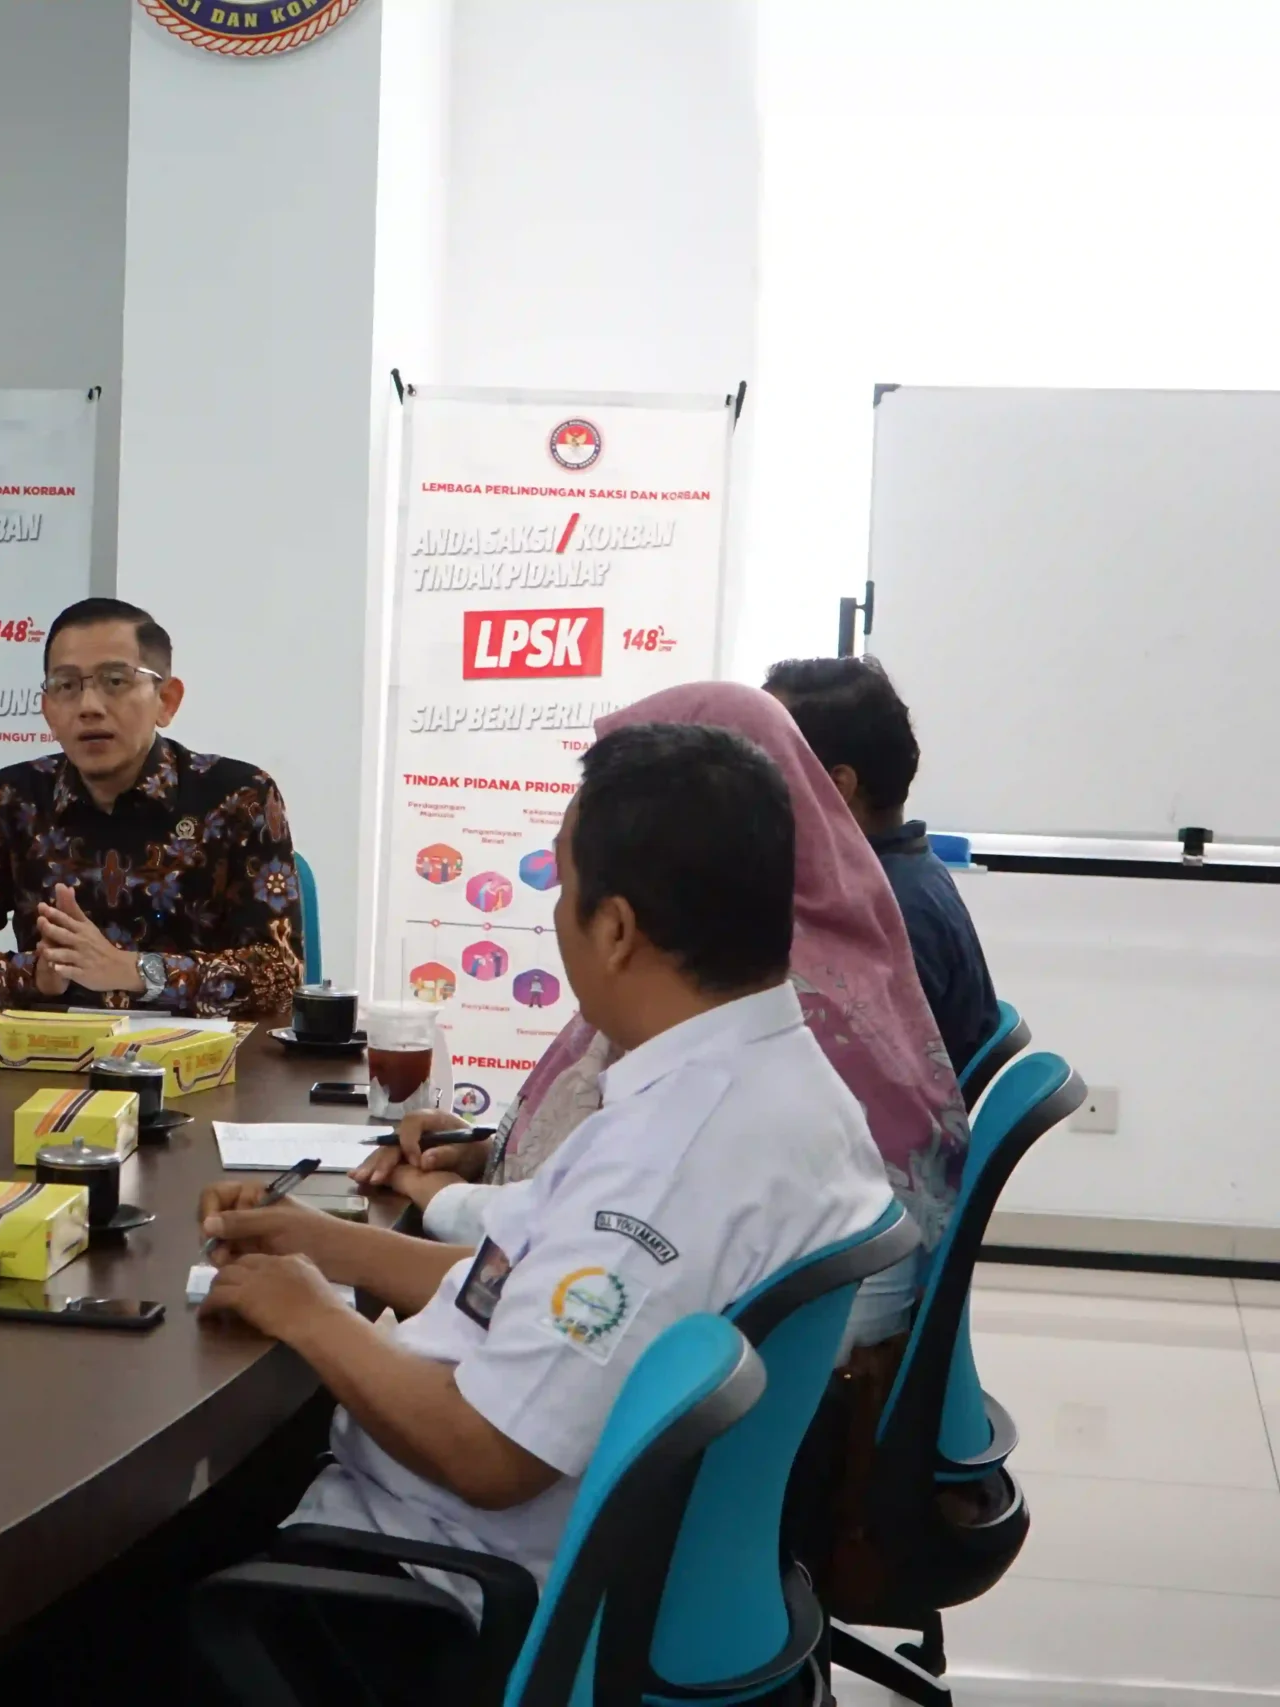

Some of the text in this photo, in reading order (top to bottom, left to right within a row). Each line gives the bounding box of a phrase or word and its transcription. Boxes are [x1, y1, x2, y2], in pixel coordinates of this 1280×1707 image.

[210, 8, 258, 27] DAN
[23, 486, 76, 496] KORBAN
[422, 483, 711, 501] LEMBAGA PERLINDUNGAN SAKSI DAN KORBAN
[412, 562, 503, 591] TINDAK
[474, 617, 588, 668] LPSK
[623, 628, 658, 651] 148
[409, 705, 467, 733] SIAP
[468, 703, 524, 731] BERI
[562, 740, 593, 750] TIDA
[403, 774, 459, 788] TINDAK
[464, 777, 521, 792] PIDANA
